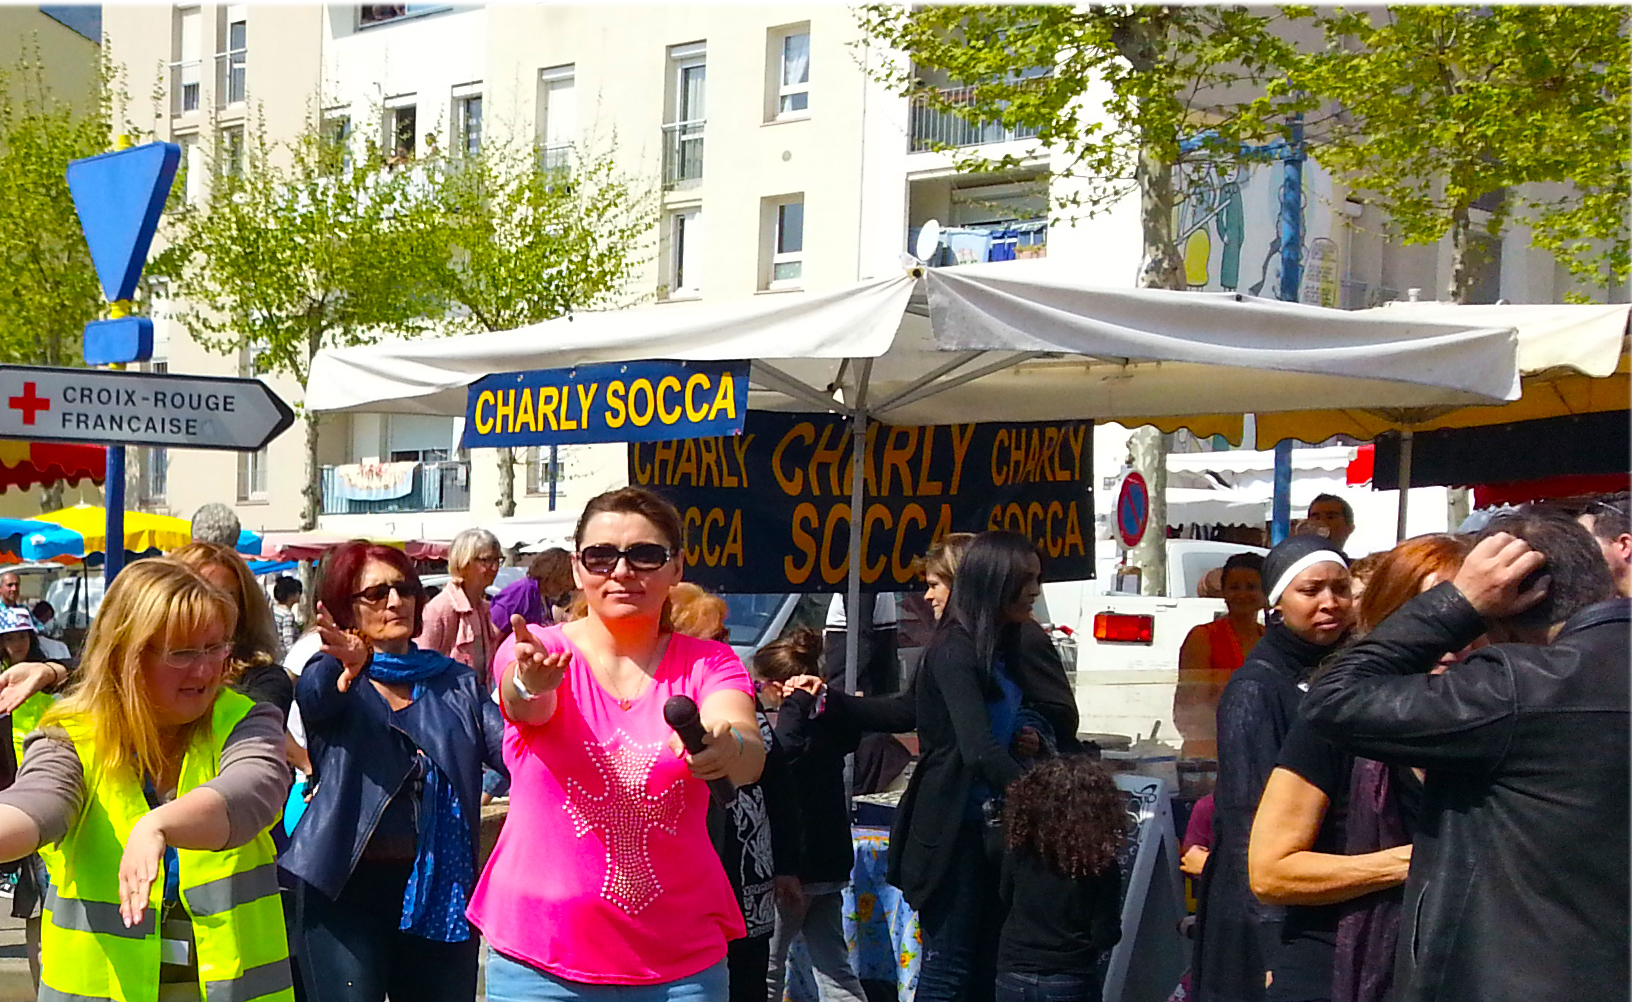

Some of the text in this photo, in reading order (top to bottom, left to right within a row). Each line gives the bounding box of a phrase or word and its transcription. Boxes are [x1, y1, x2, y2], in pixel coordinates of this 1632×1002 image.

[61, 412, 198, 436] FRANÇAISE
[62, 386, 236, 413] CROIX-ROUGE
[474, 371, 737, 435] CHARLY SOCCA
[633, 433, 756, 489] CHARLY
[772, 421, 975, 497] CHARLY
[990, 424, 1086, 487] CHARLY
[681, 506, 744, 567] CCA
